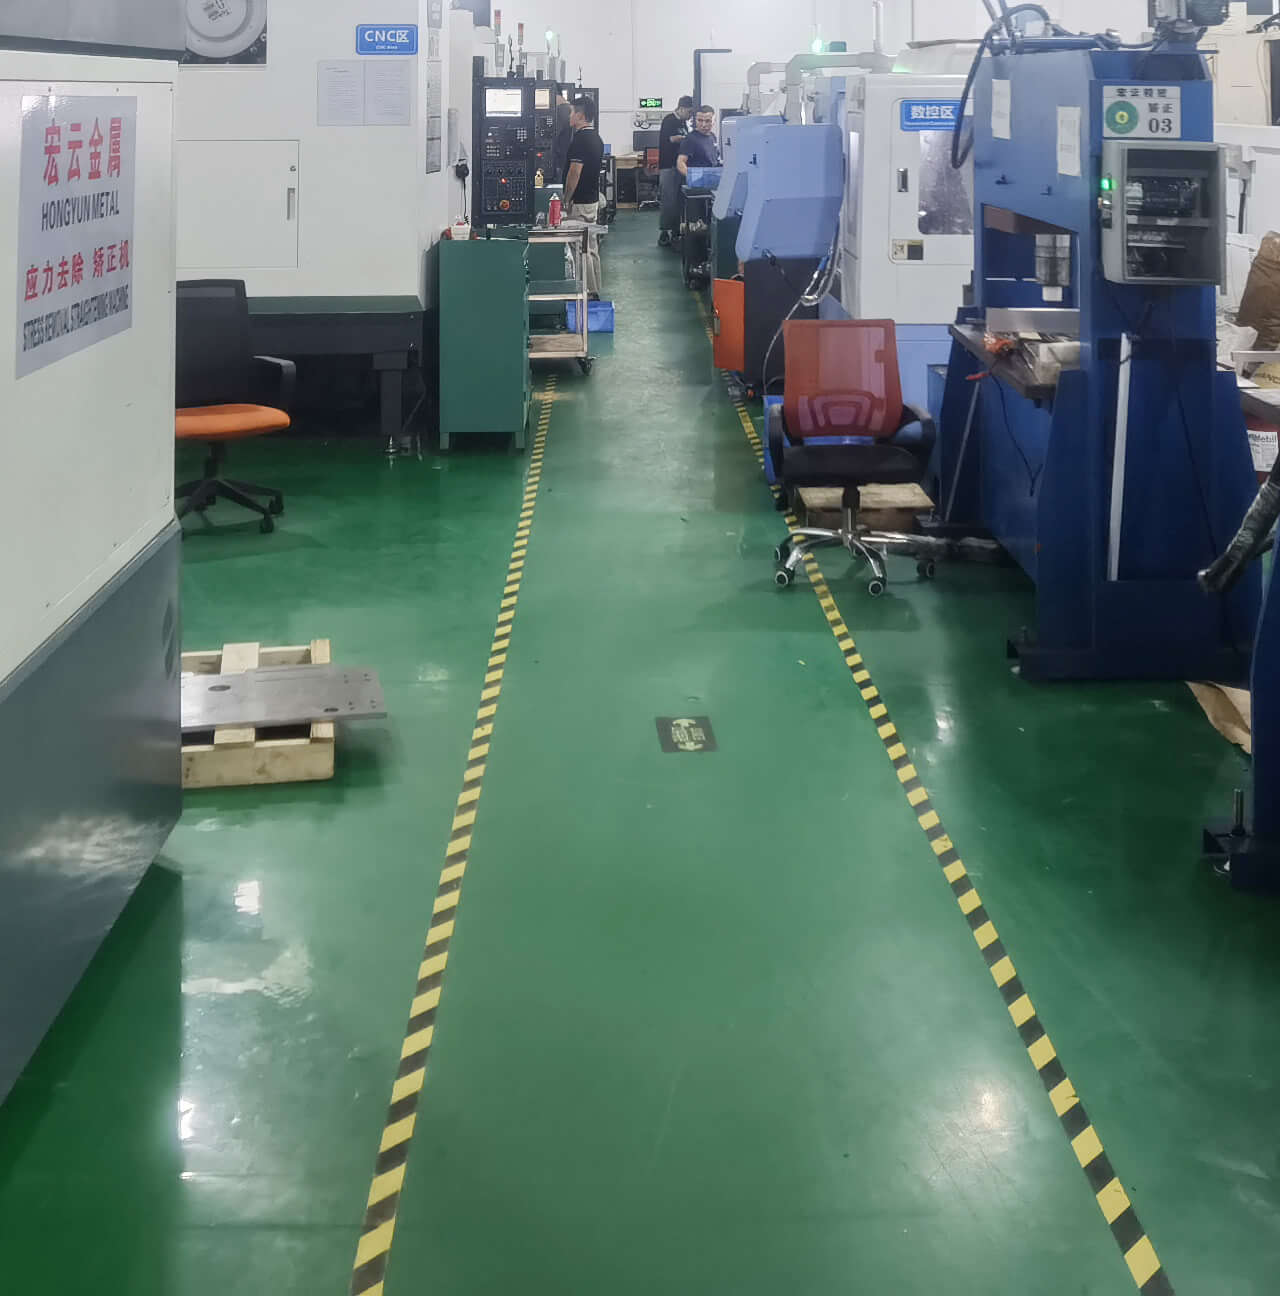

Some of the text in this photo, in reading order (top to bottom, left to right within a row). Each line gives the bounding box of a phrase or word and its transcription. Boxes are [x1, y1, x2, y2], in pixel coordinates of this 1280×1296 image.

[43, 117, 123, 186] 宏云金属
[1148, 118, 1172, 134] 03
[41, 190, 120, 232] HONGYUN METAL
[24, 239, 130, 302] 应力去除 矫正机
